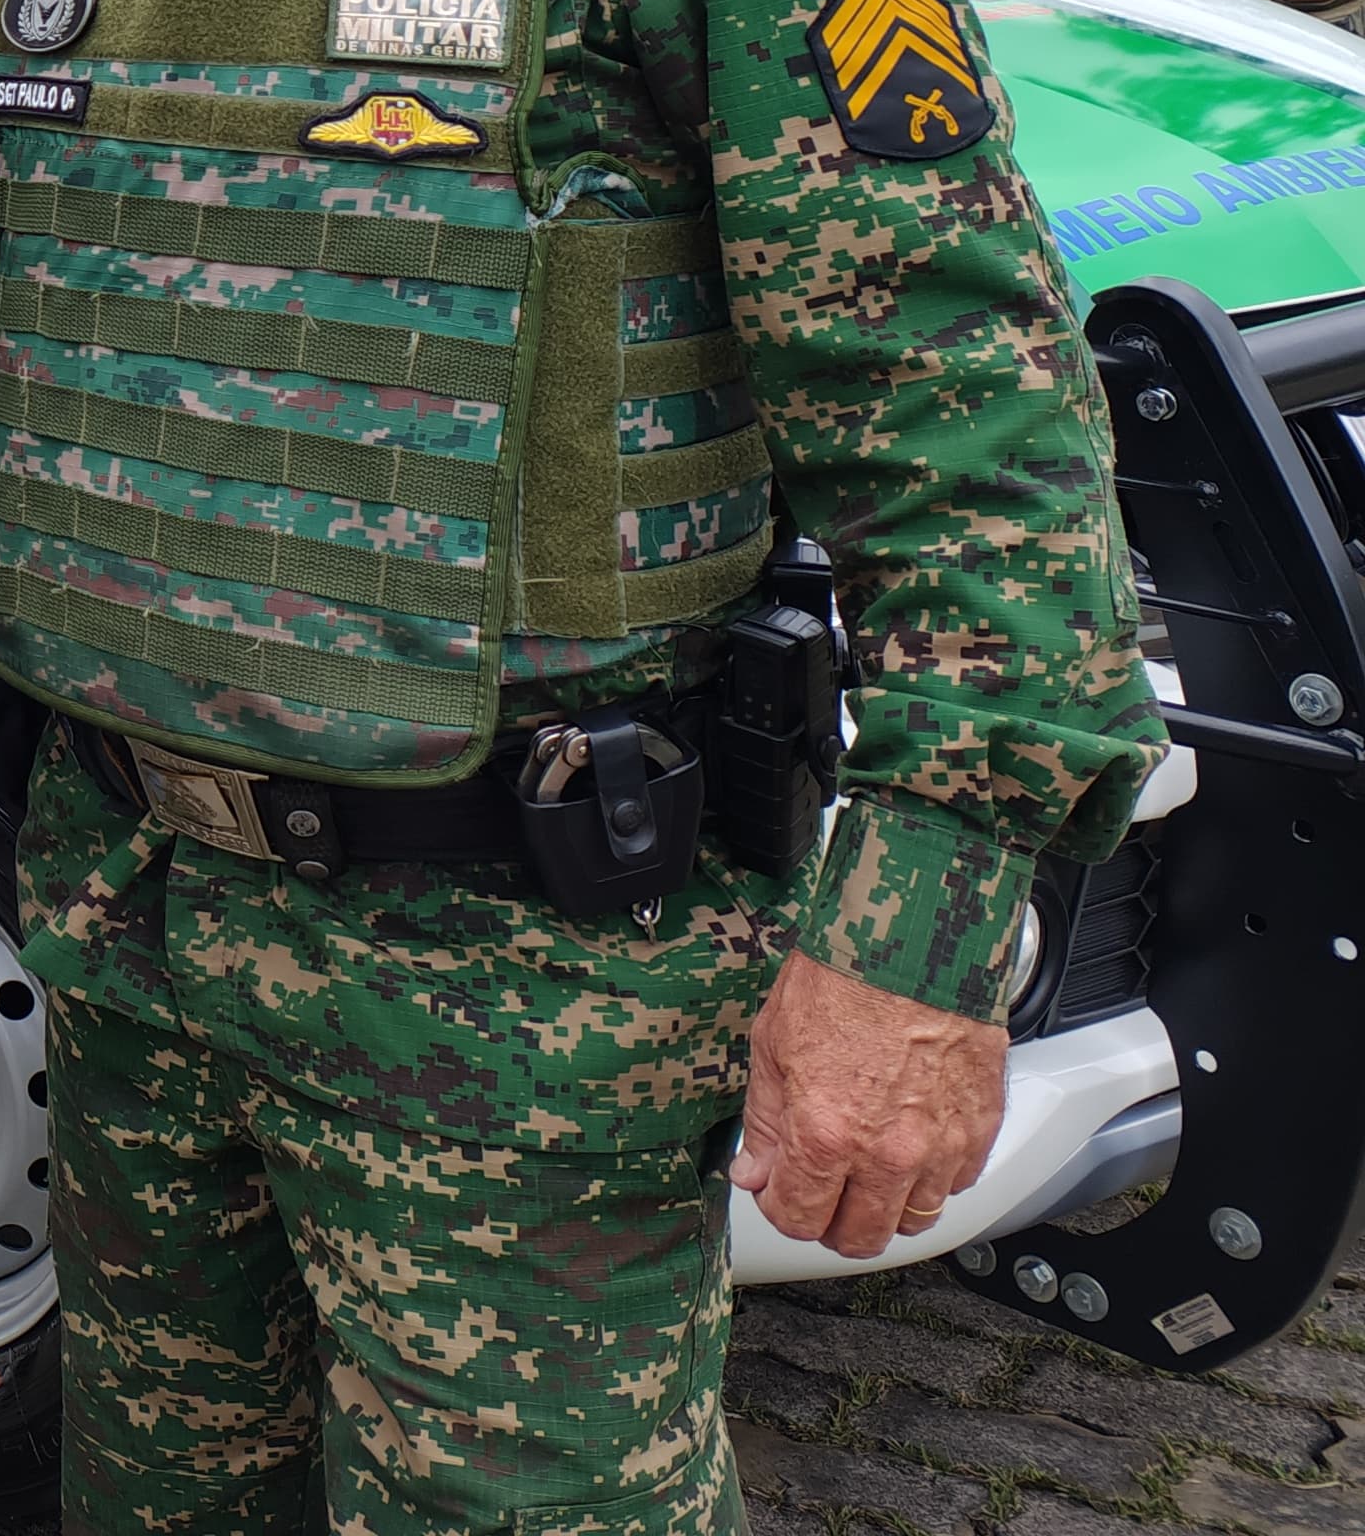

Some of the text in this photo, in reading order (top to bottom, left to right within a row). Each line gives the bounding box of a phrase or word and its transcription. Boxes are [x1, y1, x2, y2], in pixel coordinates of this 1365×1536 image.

[335, 17, 500, 47] MILITAR
[335, 39, 500, 61] DE MINAS GERAIS
[16, 83, 58, 110] PAULO
[1049, 185, 1202, 263] MEIO
